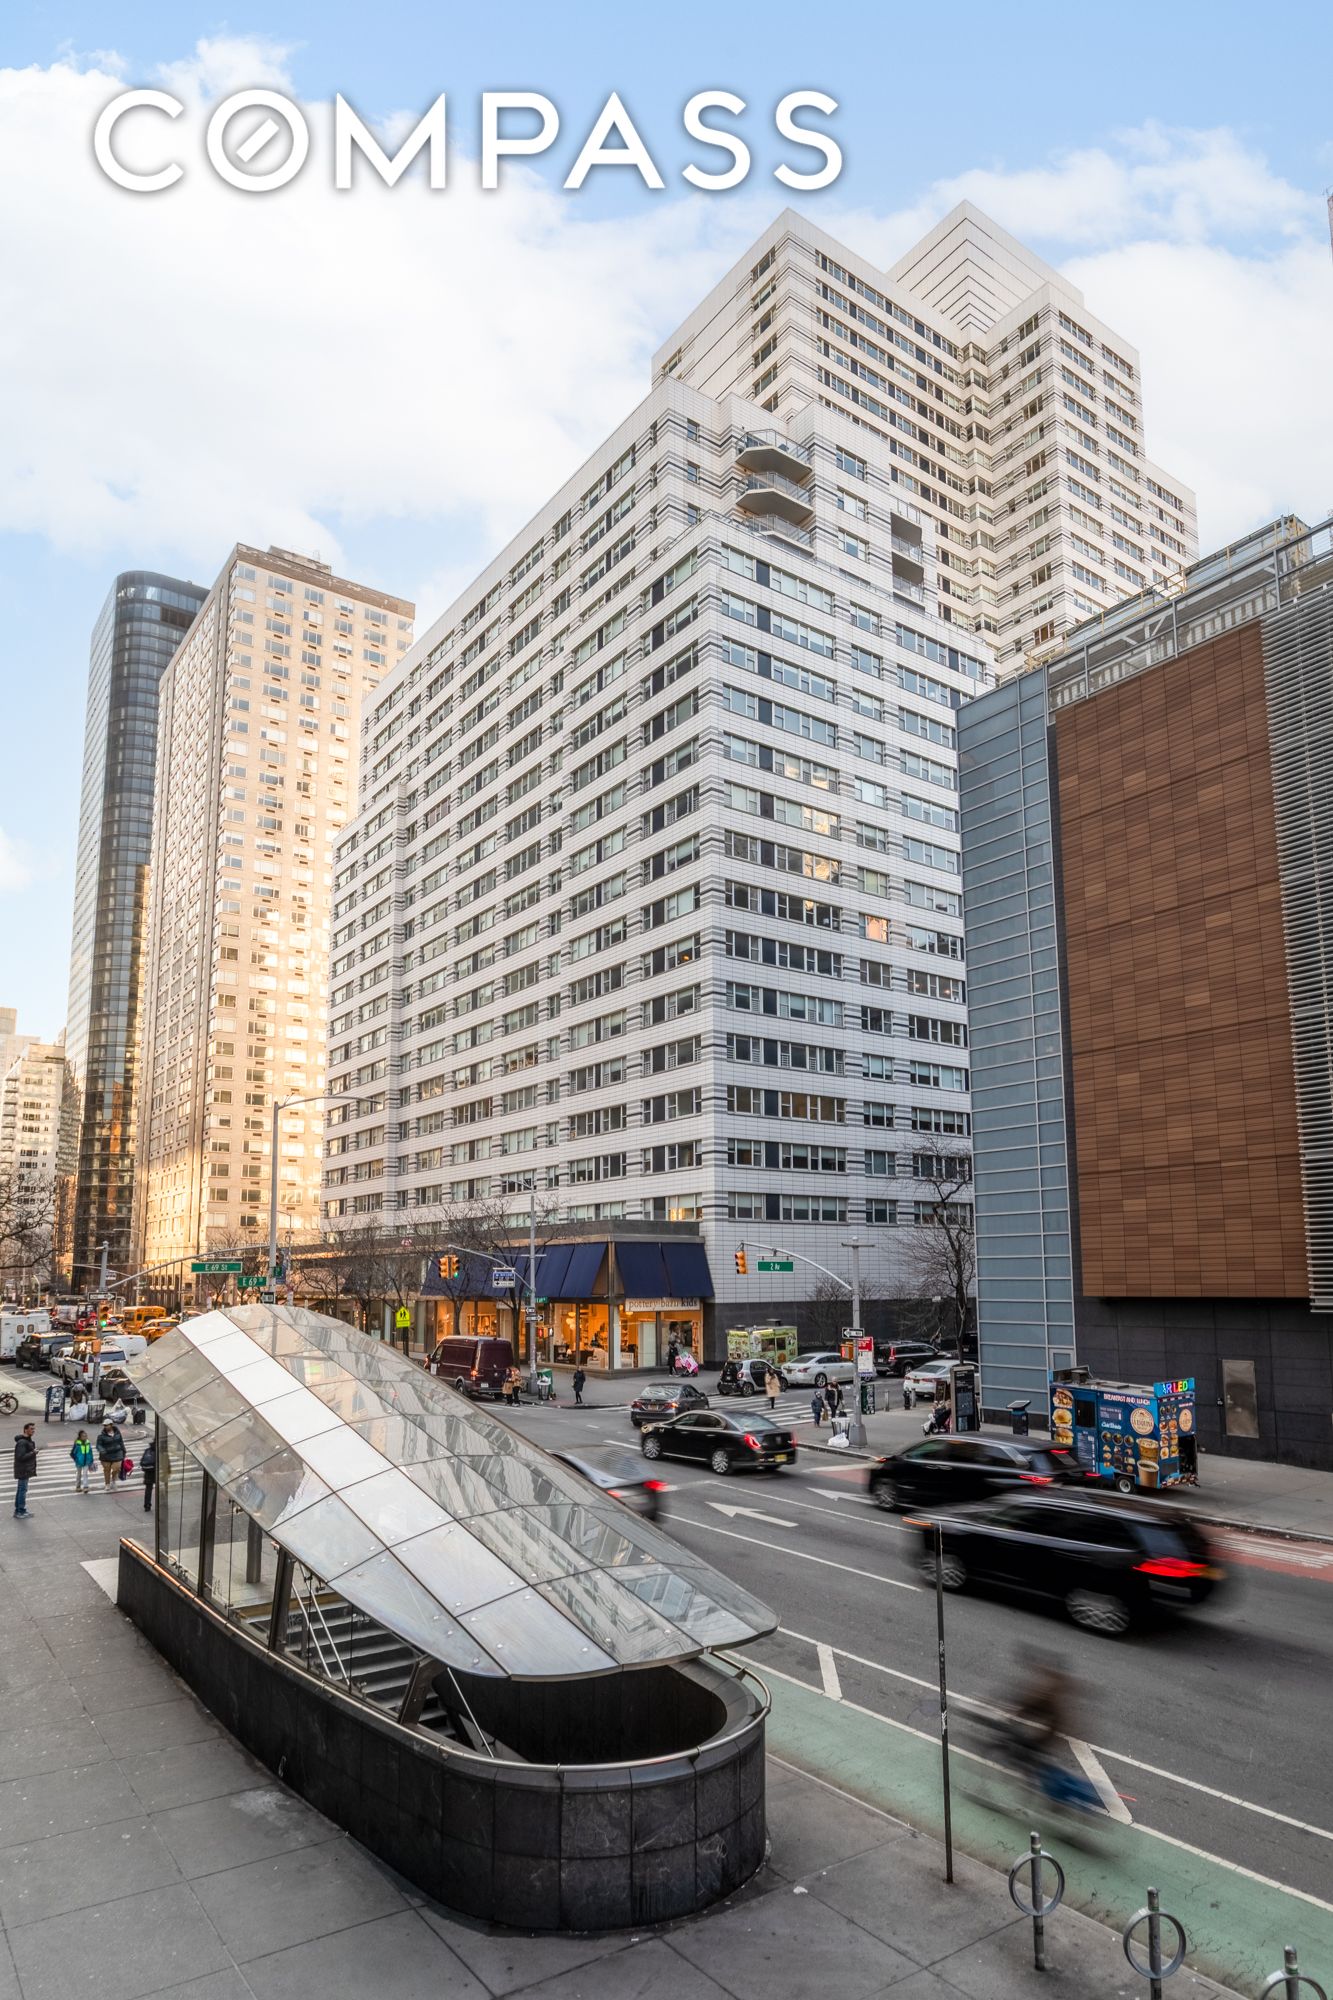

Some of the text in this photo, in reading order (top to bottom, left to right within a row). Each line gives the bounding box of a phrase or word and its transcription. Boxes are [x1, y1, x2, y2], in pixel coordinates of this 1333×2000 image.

[205, 1263, 228, 1271] E 69 St
[770, 1263, 774, 1271] 2
[242, 1278, 247, 1286] E
[248, 1278, 258, 1286] 69
[629, 1300, 657, 1312] pottery
[681, 1297, 698, 1308] kids
